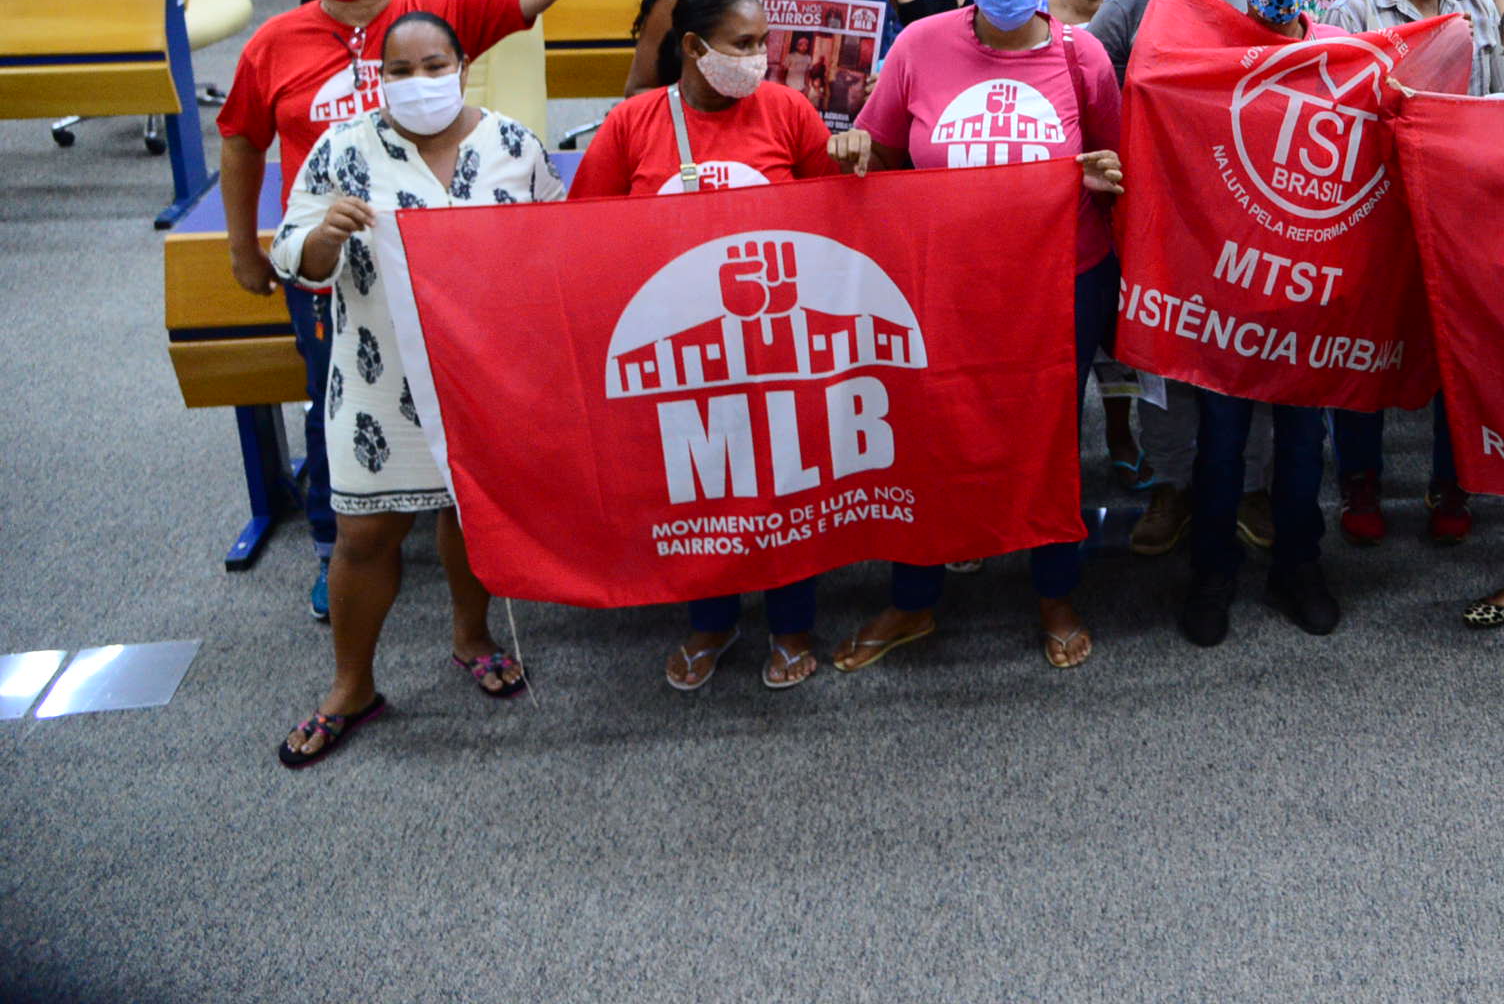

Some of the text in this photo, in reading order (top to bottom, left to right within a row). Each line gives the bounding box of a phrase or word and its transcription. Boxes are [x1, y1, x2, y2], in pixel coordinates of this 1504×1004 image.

[764, 0, 798, 13] LUTA
[1212, 145, 1229, 170] NA
[1221, 169, 1250, 210] LUTA
[1248, 203, 1284, 236] PELA
[1286, 221, 1348, 243] REFORMA
[1271, 166, 1347, 205] BRASIL
[1213, 240, 1343, 307] MTST
[656, 376, 895, 504] MLB
[651, 486, 916, 540] MOVIMENTO DE LUTA NOS
[656, 503, 915, 557] BAIRROS, VILAS E FAVELAS
